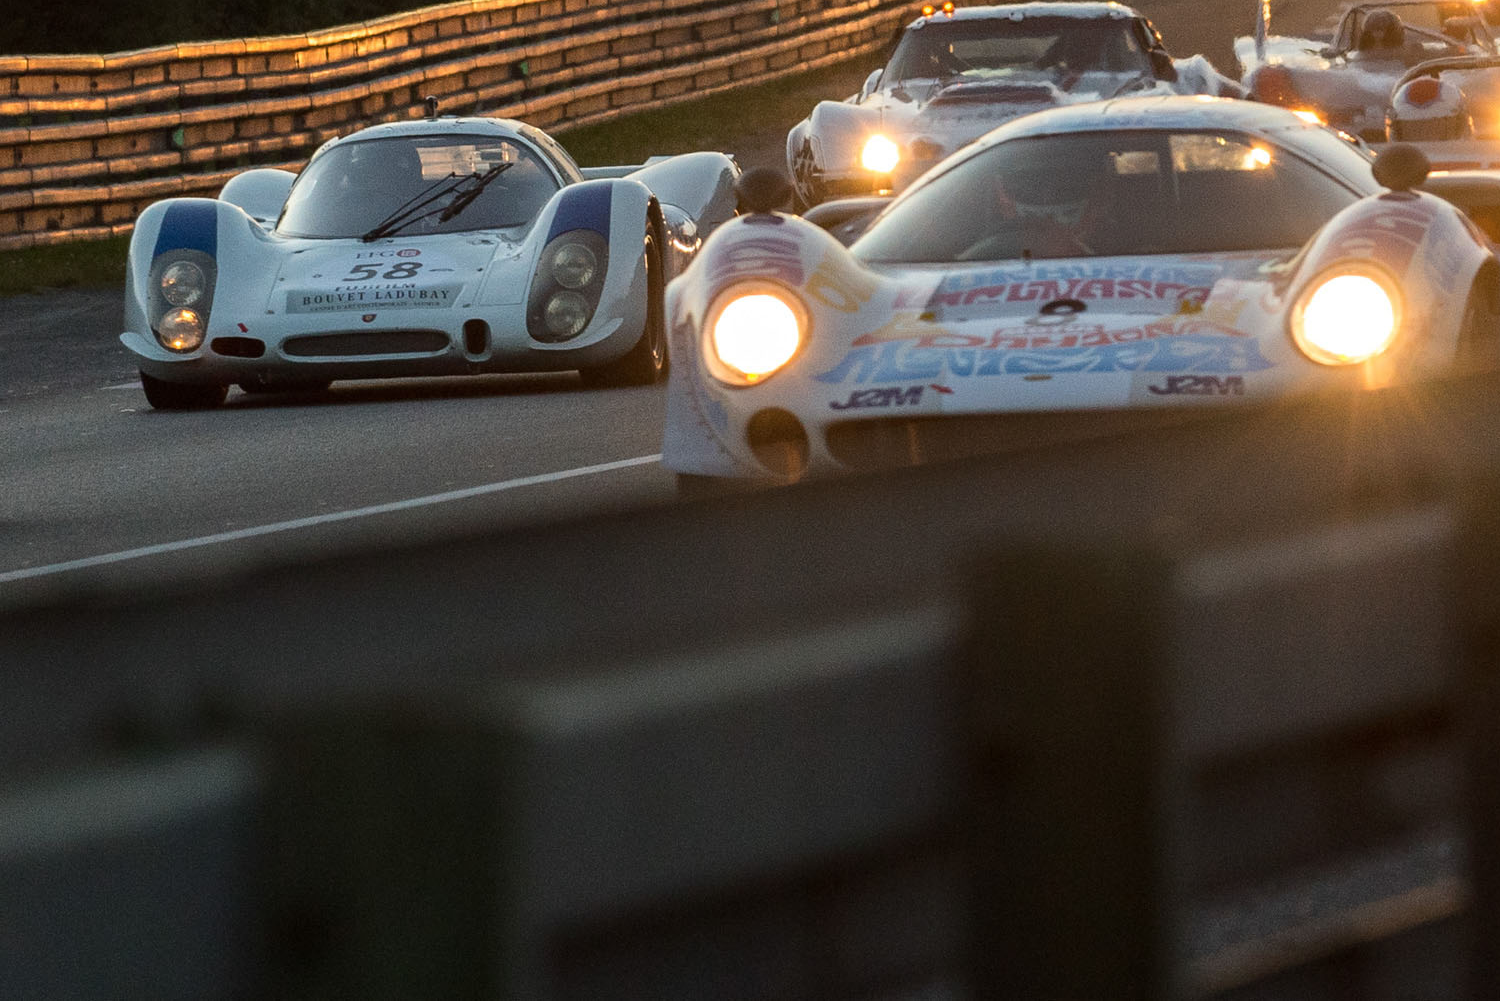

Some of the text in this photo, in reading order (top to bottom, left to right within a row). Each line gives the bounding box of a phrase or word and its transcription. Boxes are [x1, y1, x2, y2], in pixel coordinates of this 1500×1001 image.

[342, 261, 423, 282] 58
[303, 289, 449, 305] BOUVET LADUBAY
[1148, 375, 1245, 396] J2M
